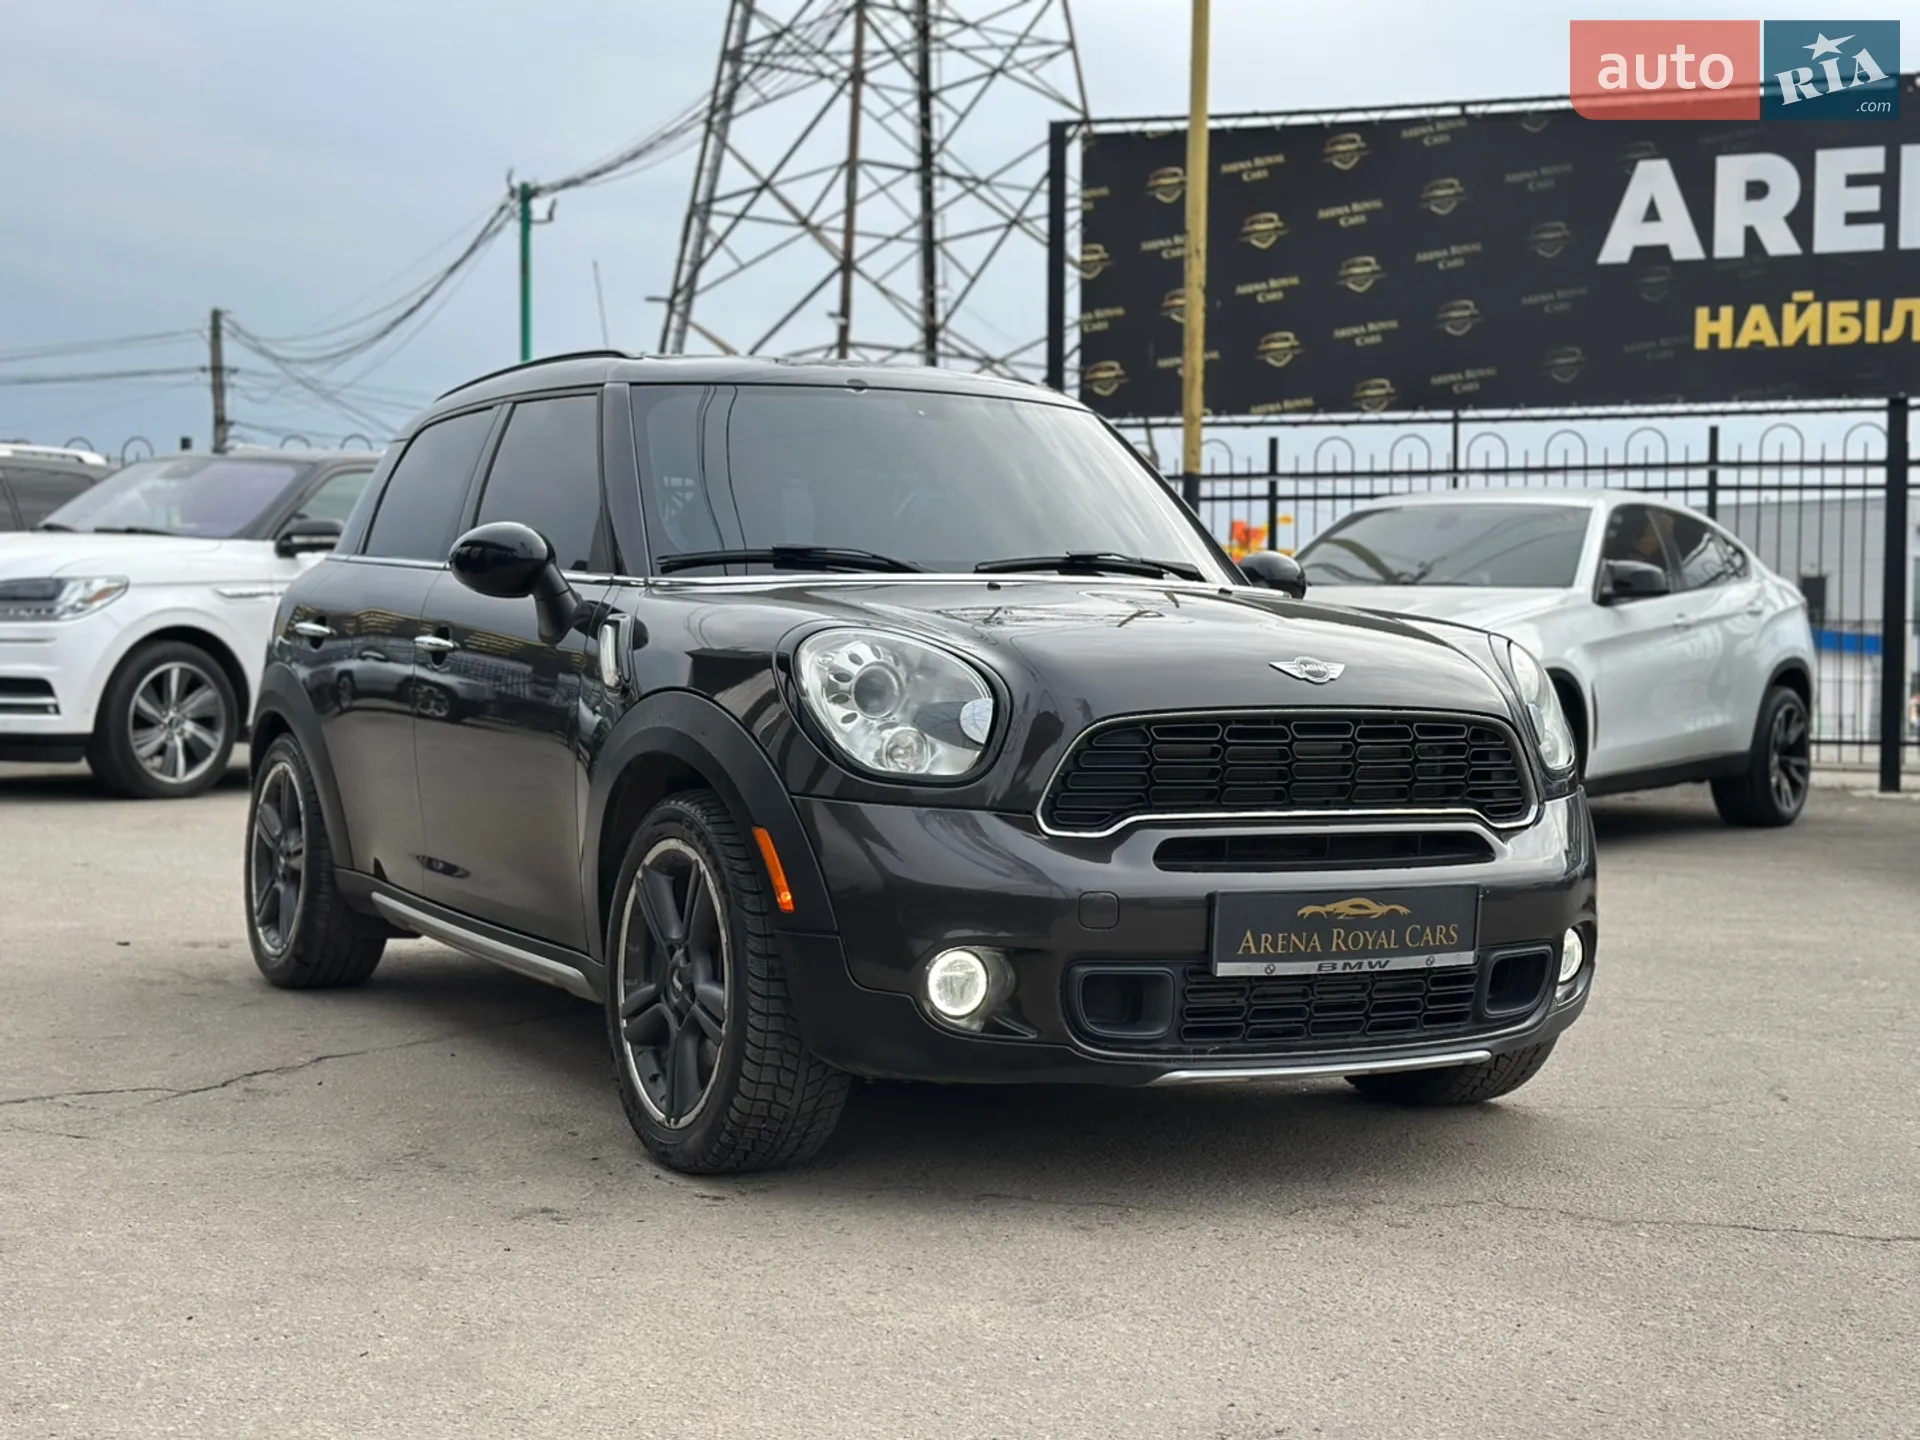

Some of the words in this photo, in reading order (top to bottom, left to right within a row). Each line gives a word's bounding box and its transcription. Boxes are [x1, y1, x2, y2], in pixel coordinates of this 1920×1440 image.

[1596, 143, 1920, 265] ARE
[1694, 290, 1920, 350] НАЙБІЛ
[1237, 929, 1321, 955] ARENA
[1331, 927, 1399, 951] ROYAL
[1405, 924, 1458, 947] CARS
[1316, 959, 1390, 972] BMW
